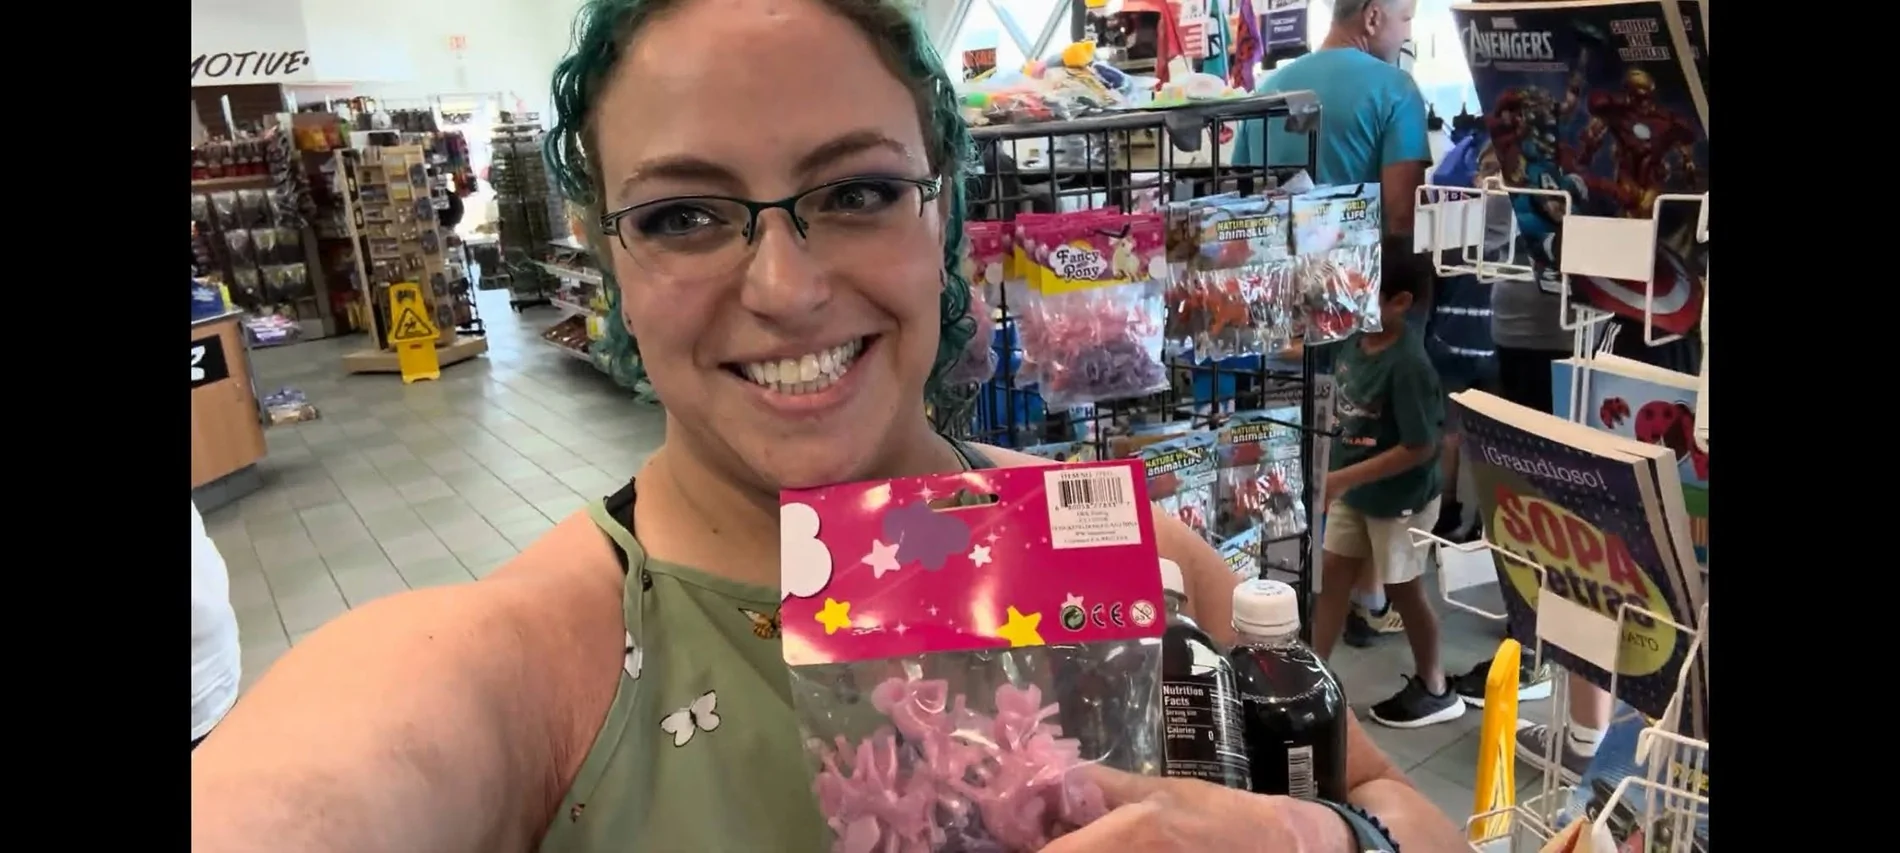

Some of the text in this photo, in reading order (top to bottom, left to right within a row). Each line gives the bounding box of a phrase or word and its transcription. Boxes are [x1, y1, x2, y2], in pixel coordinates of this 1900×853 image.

[1465, 19, 1554, 67] AVENGERS
[1056, 249, 1099, 264] Fancy
[1064, 264, 1099, 280] Pony
[1146, 453, 1175, 468] NATURE
[1482, 445, 1607, 490] ¡Grandioso!
[1496, 484, 1650, 600] SOPA
[1163, 686, 1204, 696] Nutrition
[1164, 696, 1190, 706] Facts
[1208, 730, 1214, 740] 0
